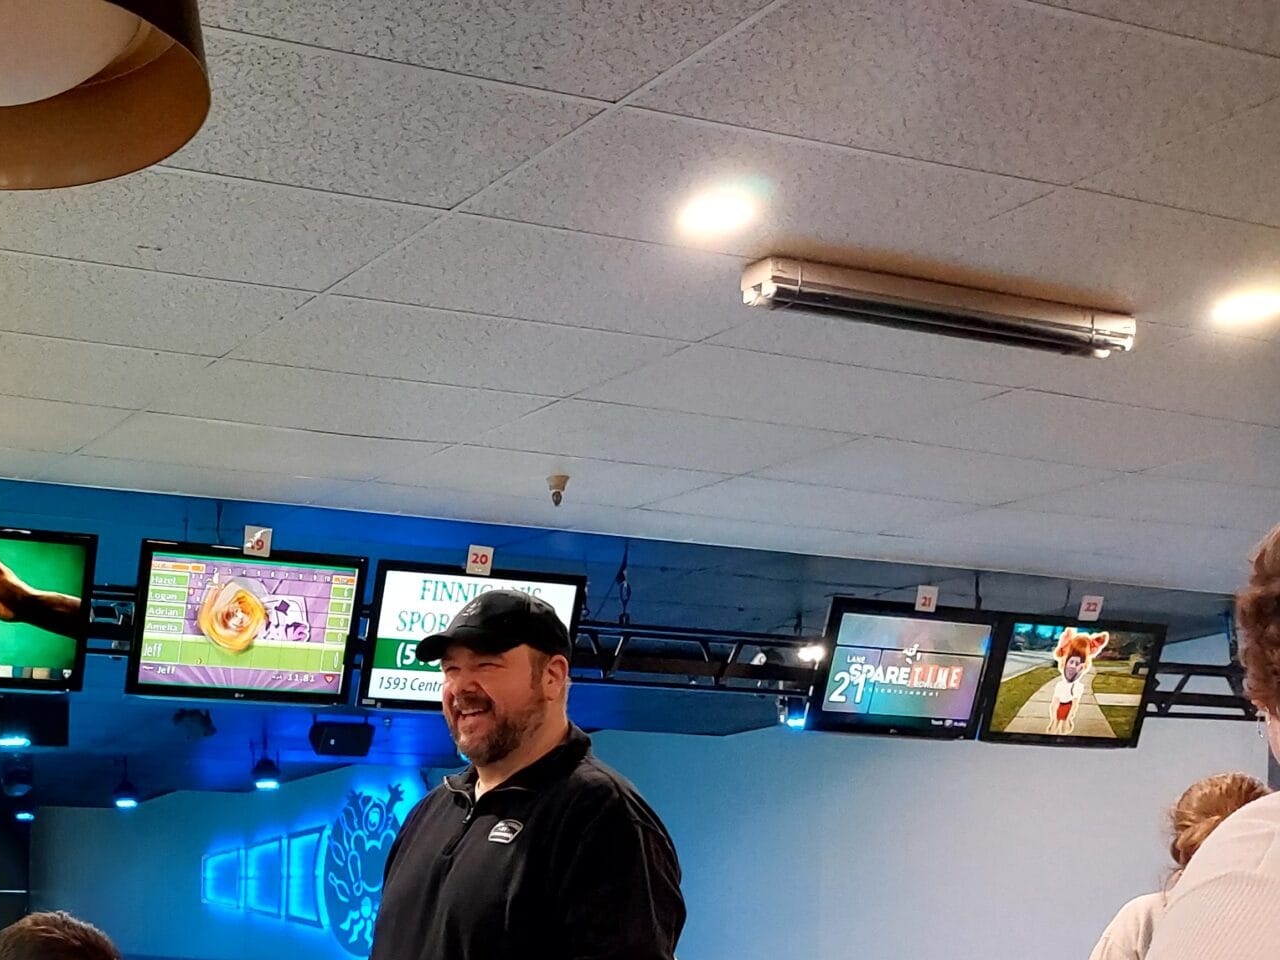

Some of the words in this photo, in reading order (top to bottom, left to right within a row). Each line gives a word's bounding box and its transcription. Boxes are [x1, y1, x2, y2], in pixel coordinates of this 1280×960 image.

[472, 553, 488, 565] 20
[921, 597, 932, 607] 21
[1084, 602, 1097, 612] 22
[148, 606, 178, 616] Adrian
[396, 609, 451, 633] SPOR
[143, 643, 162, 657] Jeff
[378, 676, 407, 690] 1593
[829, 672, 865, 704] 21
